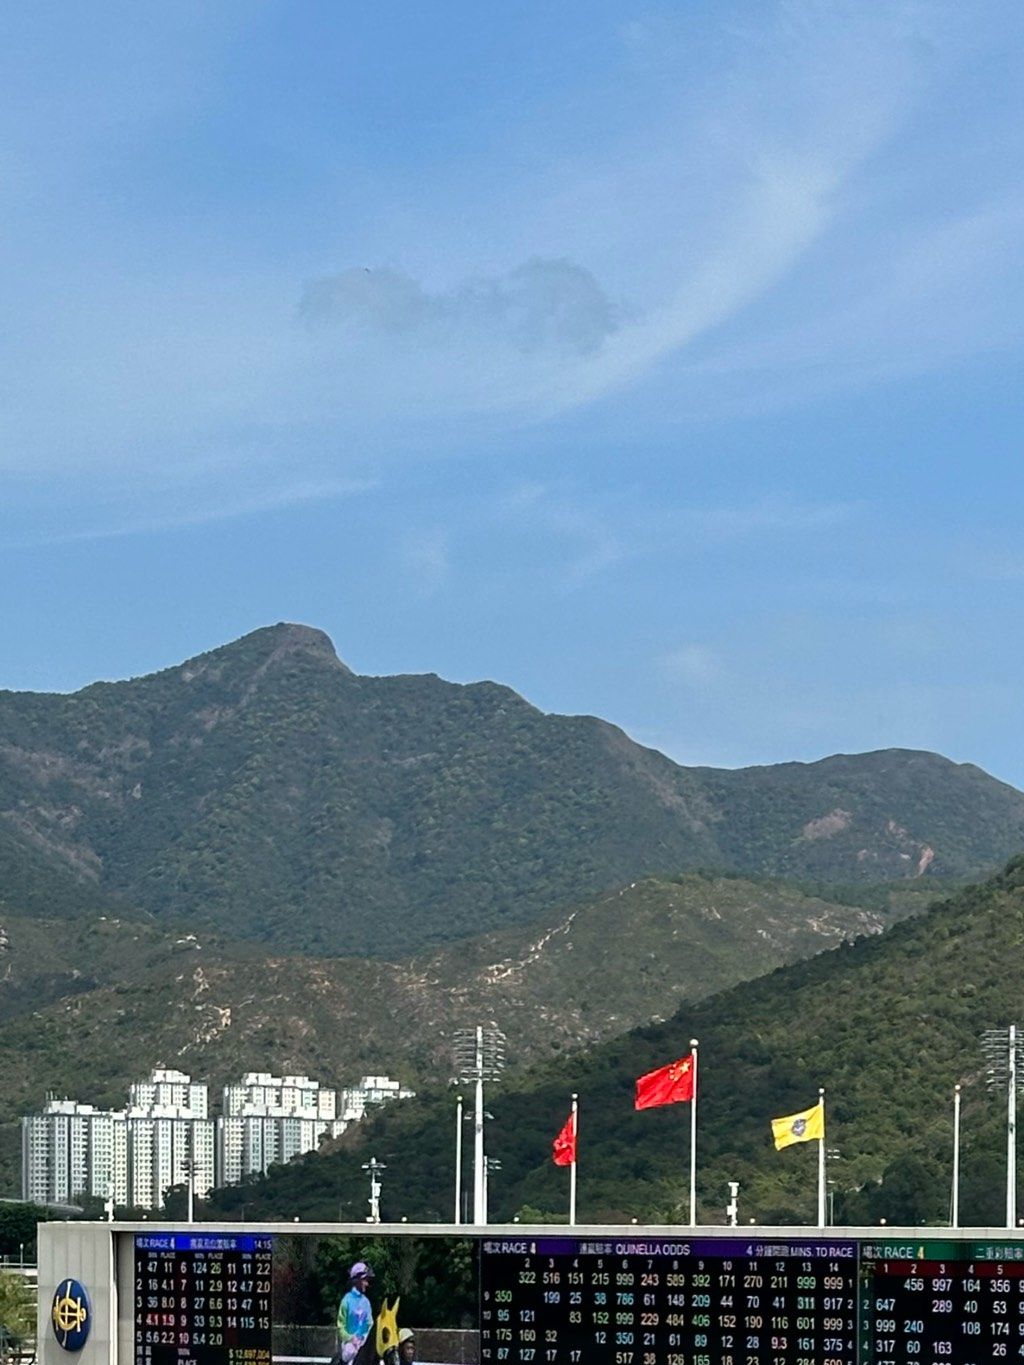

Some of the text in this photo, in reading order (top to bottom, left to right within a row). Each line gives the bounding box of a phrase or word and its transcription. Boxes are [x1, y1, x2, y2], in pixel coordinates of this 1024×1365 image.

[502, 1242, 536, 1254] RACE 4
[616, 1244, 662, 1255] QUINELLA
[662, 1244, 690, 1256] ODDS
[746, 1246, 752, 1255] 4
[816, 1247, 828, 1257] TO
[829, 1247, 853, 1257] RACE
[884, 1247, 914, 1258] RACE
[917, 1246, 924, 1259] 4
[138, 1261, 141, 1272] 1
[147, 1261, 158, 1272] 47
[164, 1262, 172, 1272] 11
[180, 1261, 187, 1274] 6
[193, 1262, 207, 1274] 124
[227, 1263, 236, 1274] 11
[242, 1263, 251, 1274] 11
[257, 1263, 270, 1275] 2.2
[525, 1258, 530, 1268] 2
[549, 1258, 554, 1268] 3
[573, 1259, 578, 1268] 4
[598, 1259, 603, 1268] 5
[622, 1259, 628, 1269] 6
[648, 1260, 653, 1269] 7
[699, 1261, 704, 1270] 9
[723, 1261, 732, 1271] 10
[749, 1262, 757, 1271] 11
[776, 1262, 785, 1272] 12
[802, 1262, 811, 1272] 13
[829, 1262, 838, 1272] 14
[884, 1263, 888, 1273] 1
[911, 1264, 917, 1274] 2
[940, 1264, 945, 1274] 3
[968, 1265, 974, 1274] 4
[997, 1265, 1003, 1275] 5
[137, 1278, 142, 1290] 2
[162, 1279, 174, 1290] 4.1
[181, 1279, 187, 1291] 7
[195, 1280, 203, 1291] 11
[227, 1280, 237, 1292] 12
[240, 1281, 253, 1292] 4.7
[519, 1271, 536, 1284] 322
[543, 1272, 560, 1284] 516
[568, 1272, 583, 1284] 151
[592, 1273, 609, 1285] 215
[616, 1273, 634, 1285] 999
[641, 1273, 659, 1286] 243
[692, 1274, 710, 1287] 392
[719, 1275, 735, 1287] 171
[744, 1275, 763, 1288] 270
[771, 1276, 787, 1288] 211
[797, 1276, 816, 1289] 999
[824, 1277, 843, 1290] 999
[849, 1279, 852, 1287] 1
[864, 1279, 868, 1288] 1
[904, 1278, 924, 1291] 456
[932, 1278, 952, 1292] 997
[962, 1279, 980, 1292] 164
[990, 1279, 1010, 1293] 356
[863, 1299, 869, 1310] 2
[876, 1298, 896, 1311] 647
[932, 1299, 953, 1313] 289
[964, 1300, 978, 1313] 40
[993, 1300, 1007, 1314] 53
[136, 1314, 142, 1324] 4
[181, 1315, 187, 1326] 9
[194, 1315, 205, 1327] 33
[227, 1316, 237, 1328] 14
[240, 1317, 255, 1329] 115
[259, 1317, 269, 1329] 15
[864, 1320, 869, 1330] 3
[876, 1319, 896, 1332] 999
[904, 1320, 924, 1333] 240
[961, 1321, 981, 1335] 108
[990, 1322, 1010, 1335] 174
